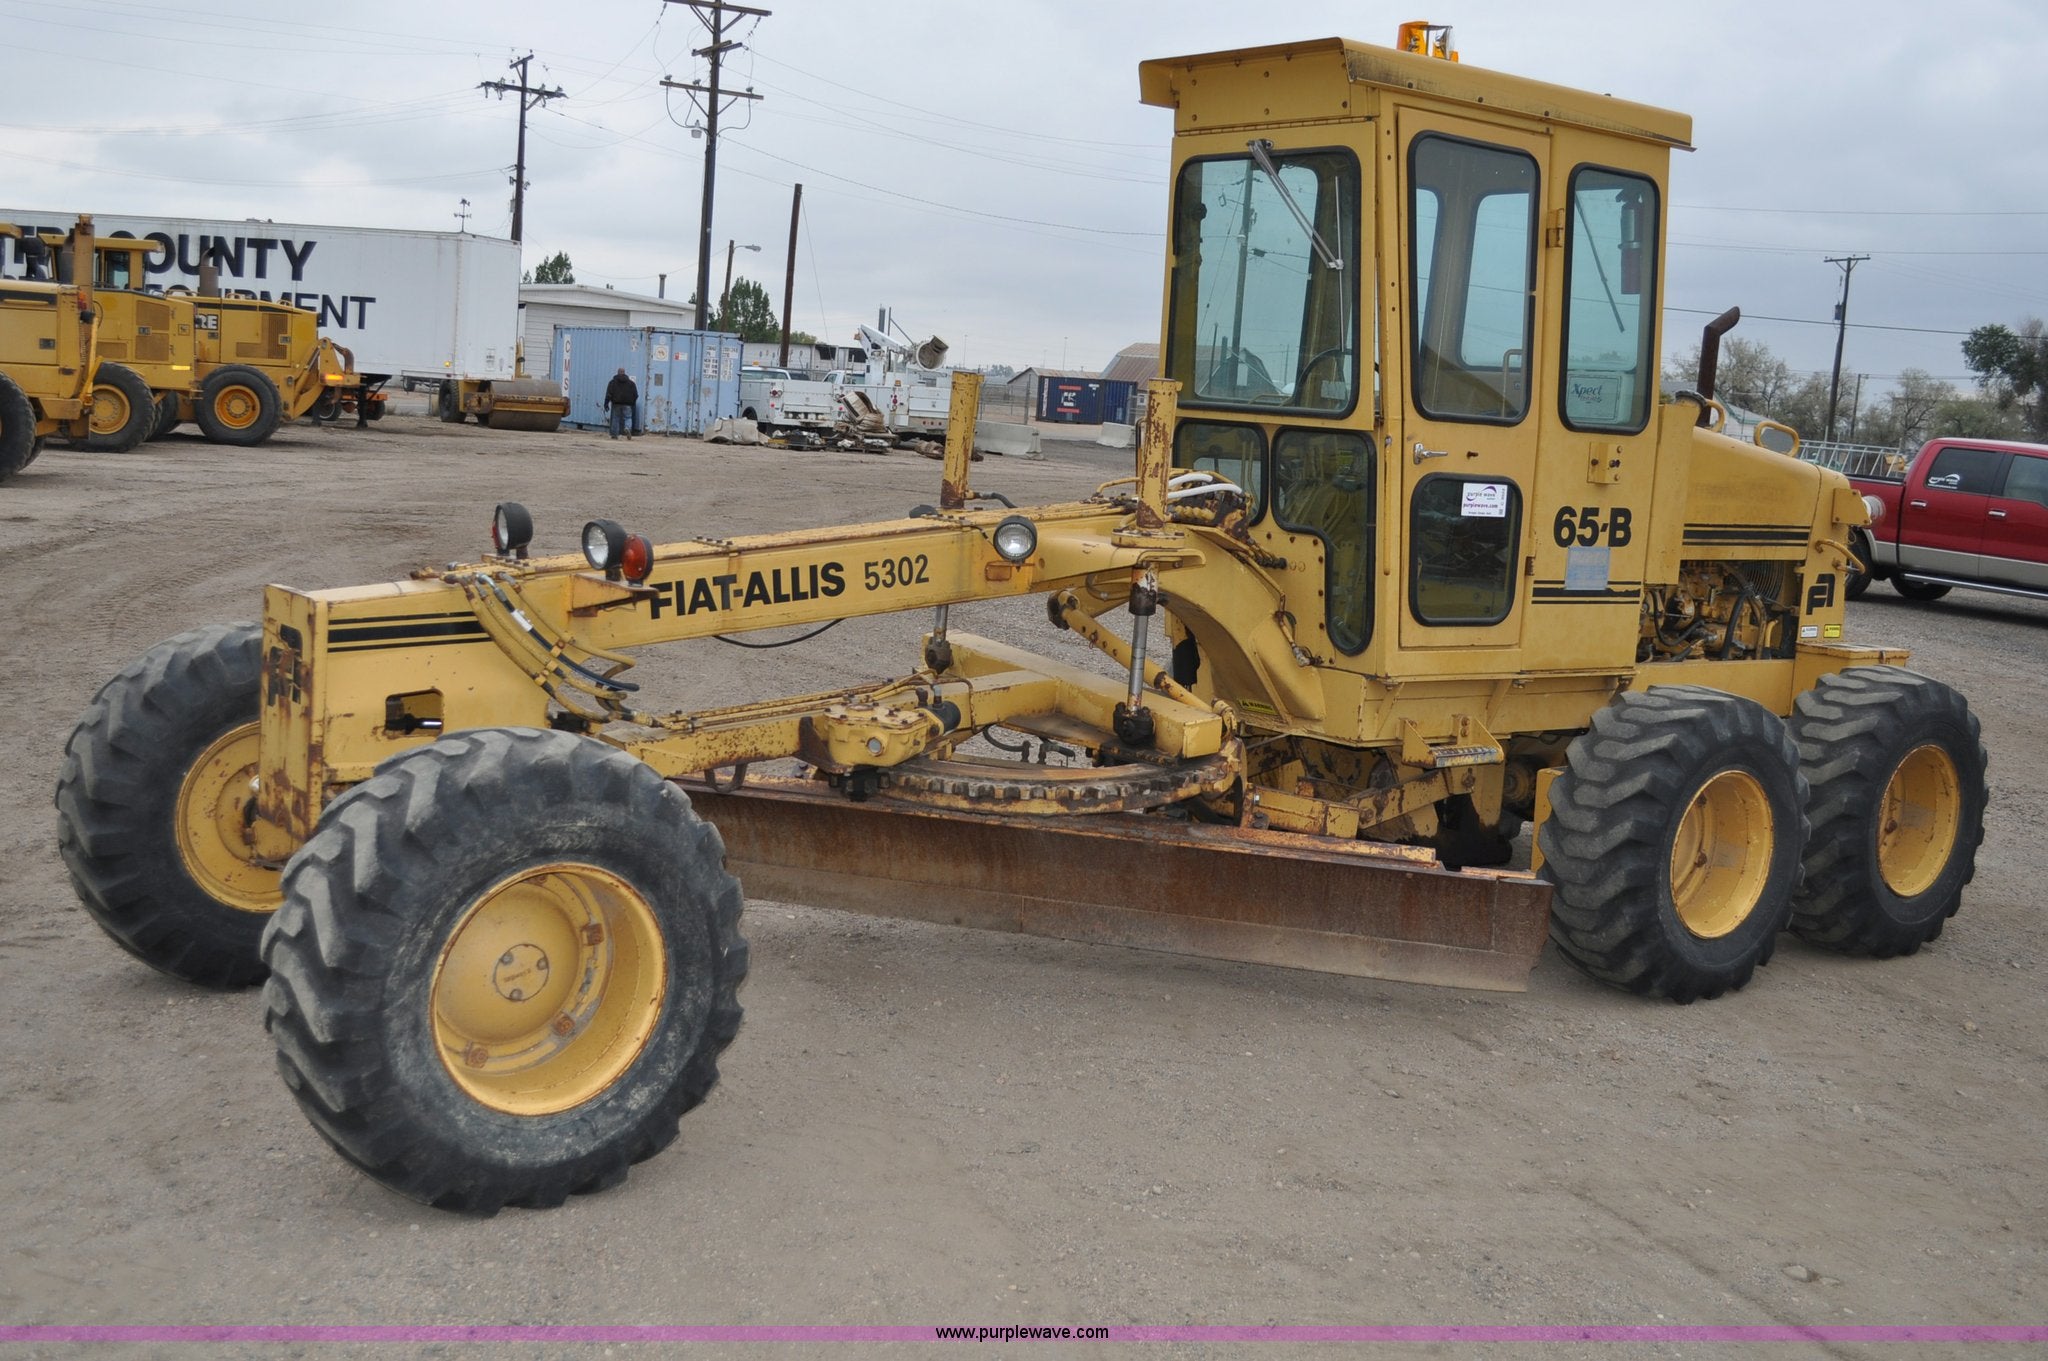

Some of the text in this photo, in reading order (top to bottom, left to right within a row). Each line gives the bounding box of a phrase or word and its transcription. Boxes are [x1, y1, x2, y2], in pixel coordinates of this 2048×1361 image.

[108, 230, 317, 281] OUNTY
[1553, 505, 1633, 548] 65-B
[650, 553, 930, 620] FIAT-ALLIS 5302
